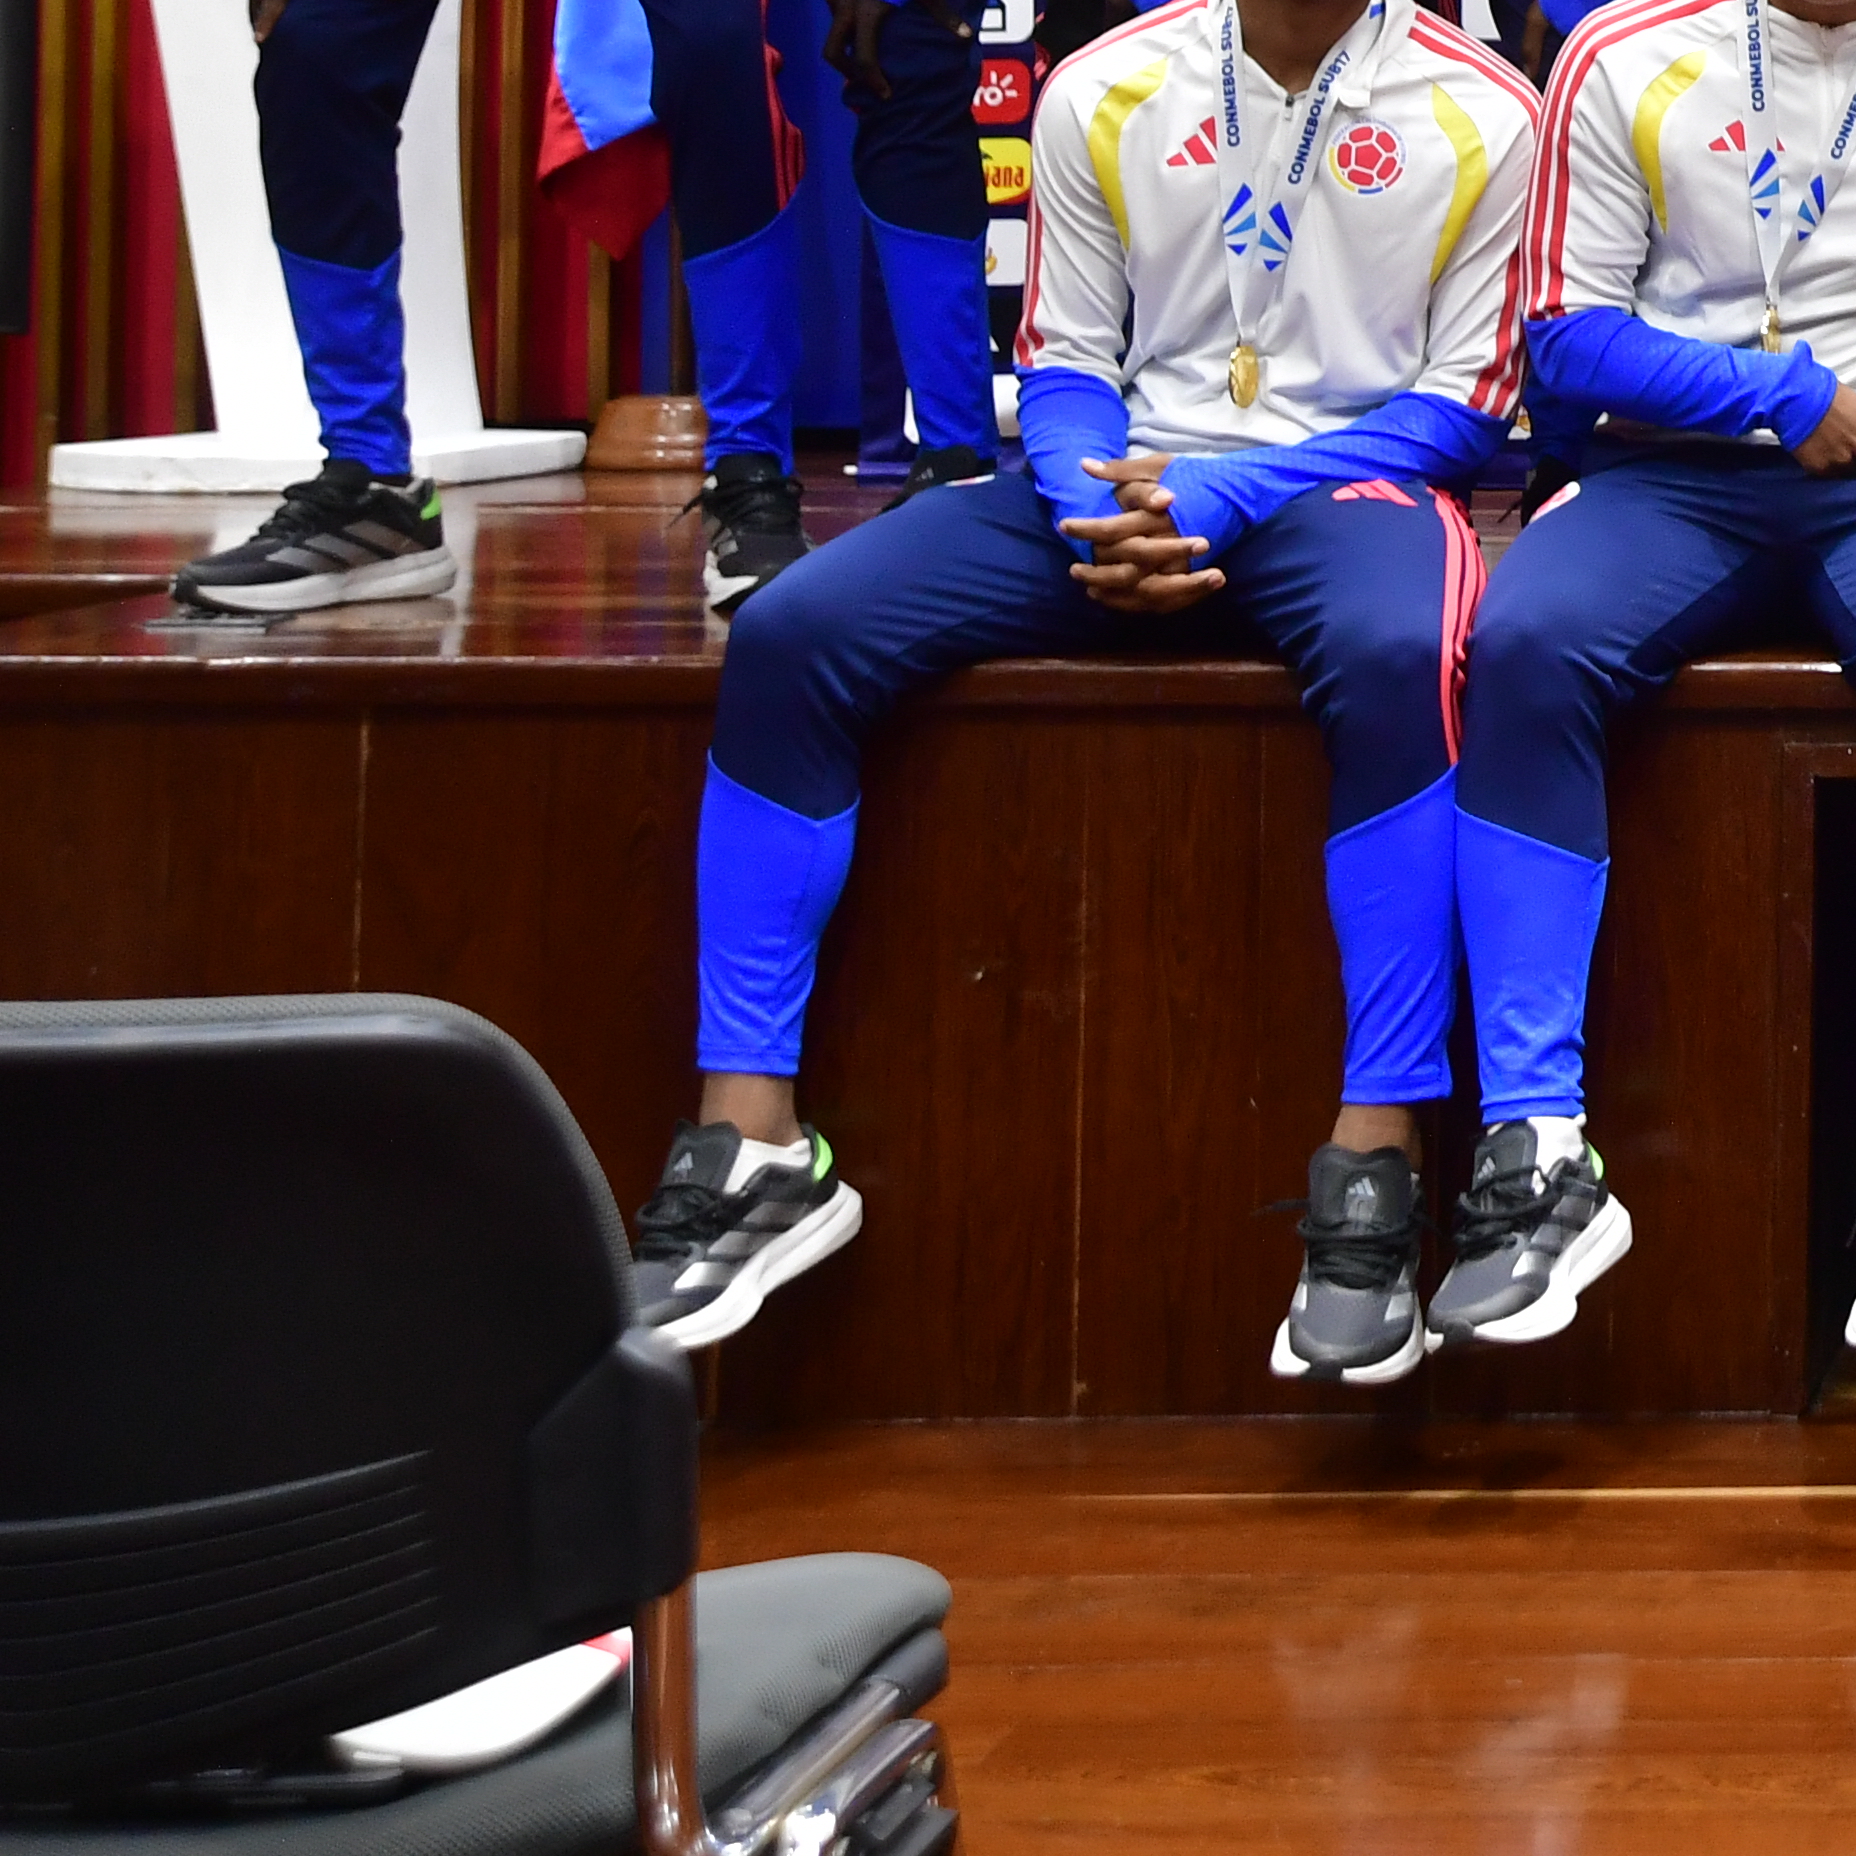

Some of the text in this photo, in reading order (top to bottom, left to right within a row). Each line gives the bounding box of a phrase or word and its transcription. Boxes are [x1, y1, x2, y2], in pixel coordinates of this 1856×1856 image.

[1223, 54, 1241, 148] CONMEBOL
[1747, 20, 1766, 113] CONMEBOL
[1287, 49, 1352, 185] CONMEBOL SUB17
